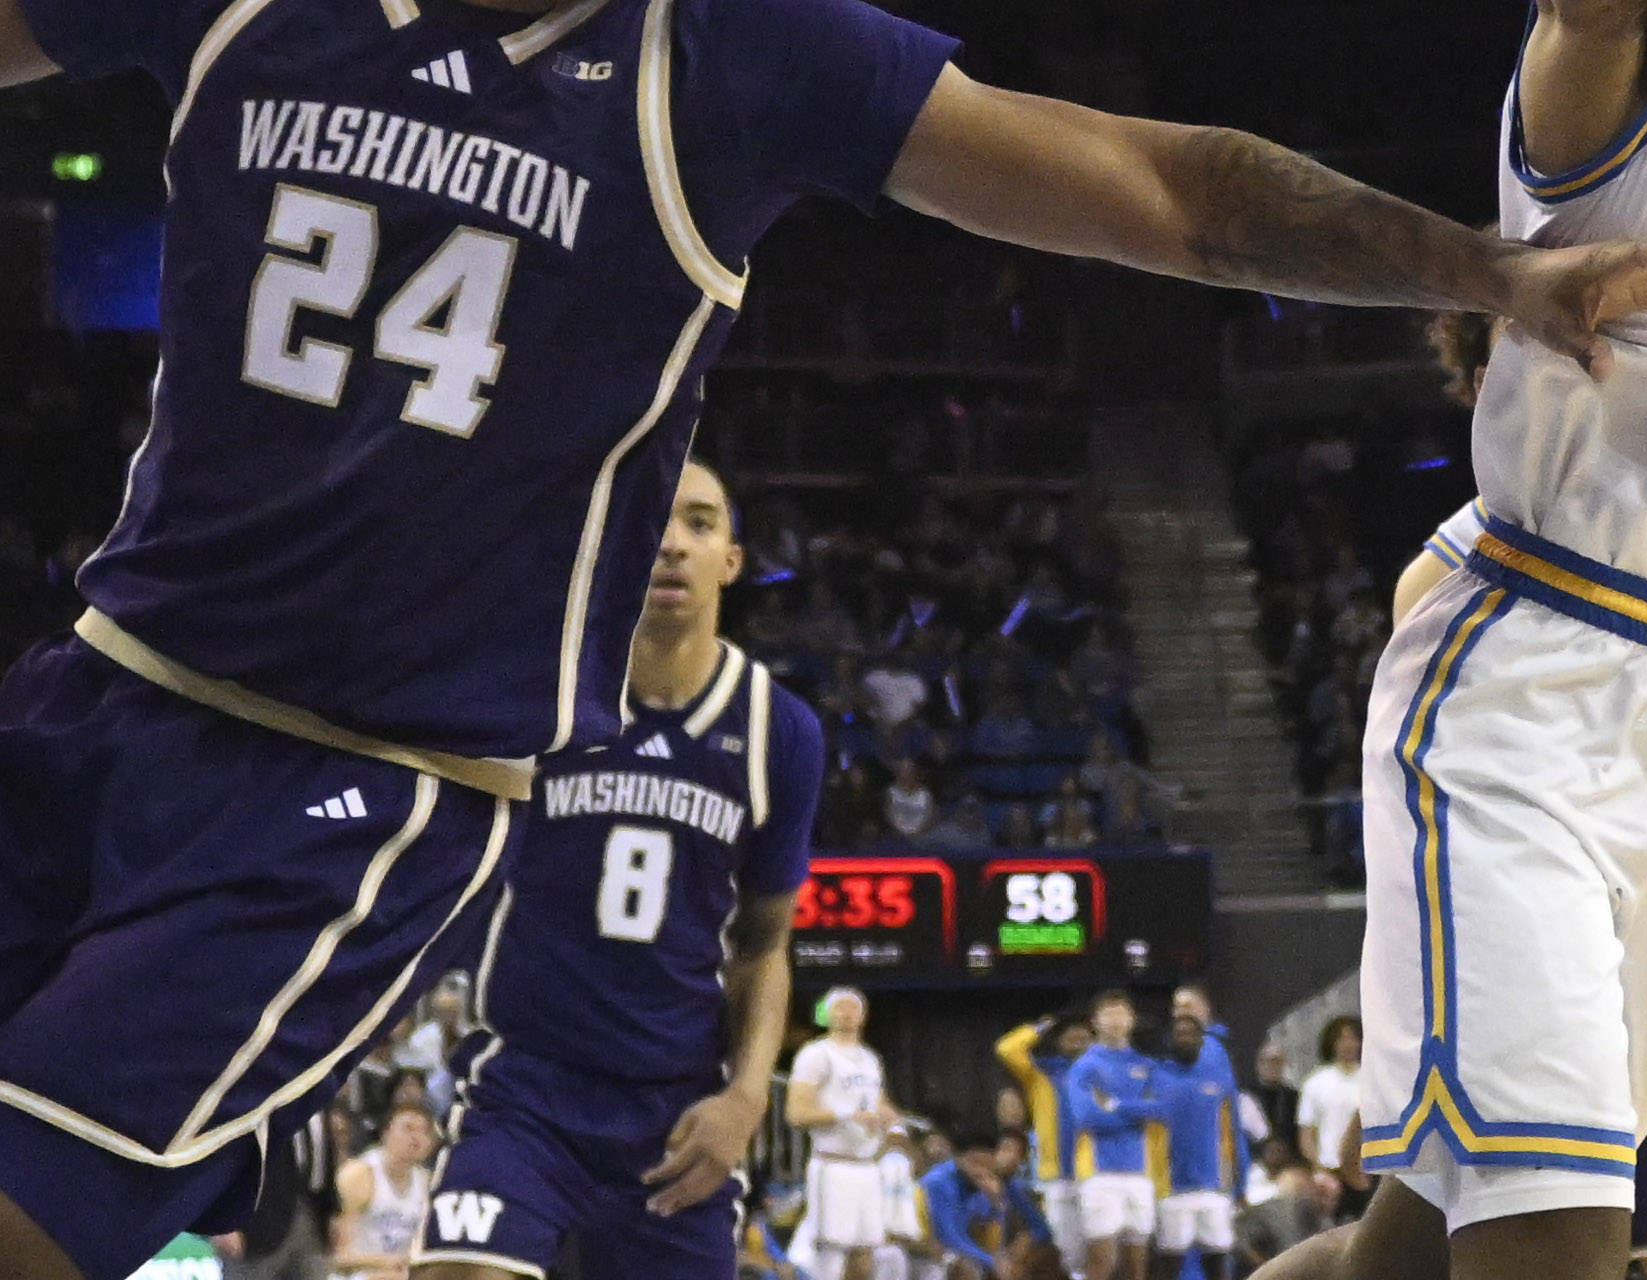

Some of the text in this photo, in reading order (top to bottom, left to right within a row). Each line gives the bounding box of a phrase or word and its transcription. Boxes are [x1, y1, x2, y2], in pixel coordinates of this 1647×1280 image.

[238, 99, 590, 252] WASHINGTON
[240, 182, 519, 440] 24
[545, 772, 745, 845] WASHINGTON
[596, 824, 674, 943] 8
[1005, 871, 1079, 924] 58
[433, 1190, 505, 1244] W
